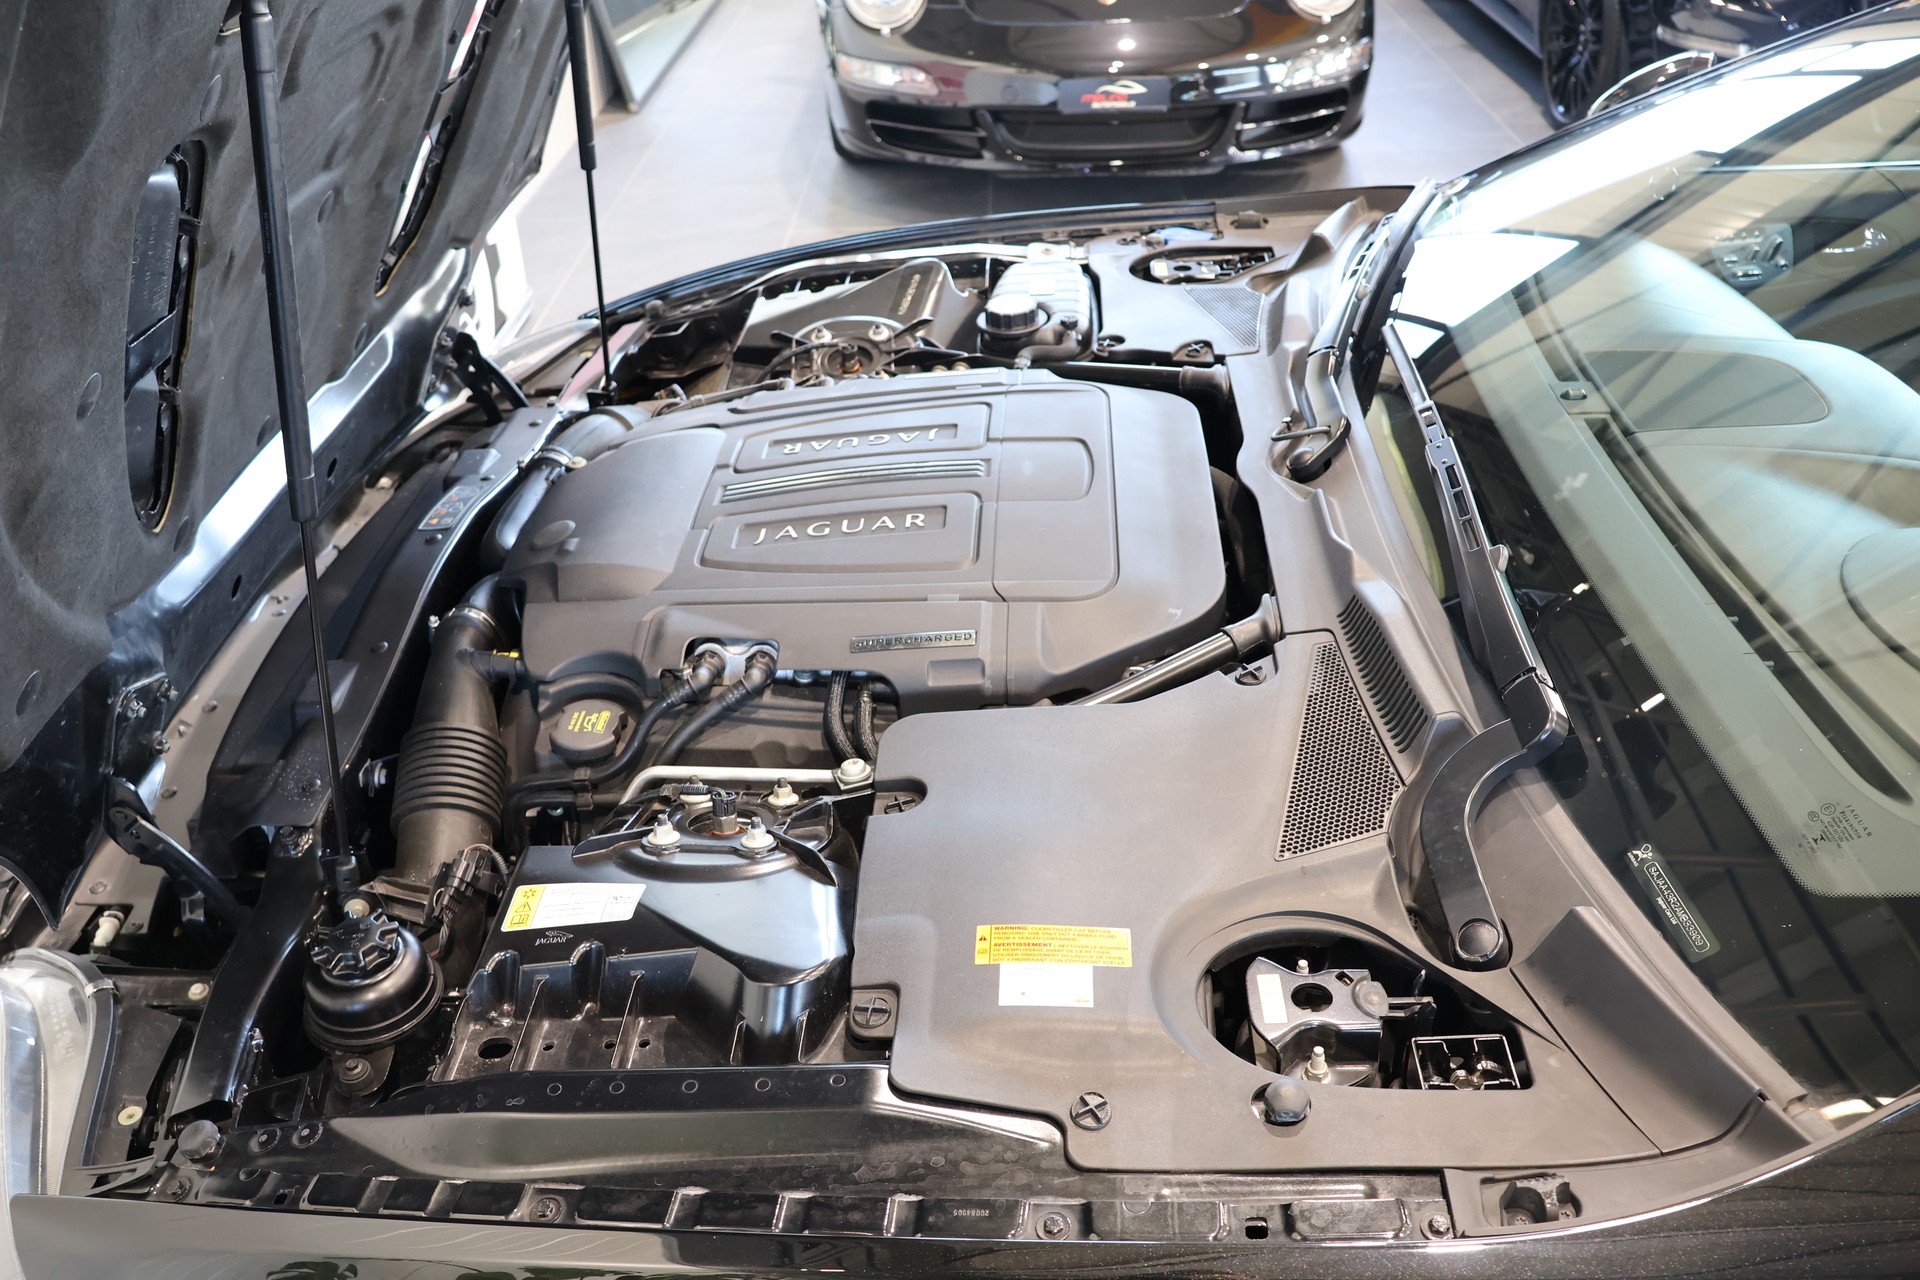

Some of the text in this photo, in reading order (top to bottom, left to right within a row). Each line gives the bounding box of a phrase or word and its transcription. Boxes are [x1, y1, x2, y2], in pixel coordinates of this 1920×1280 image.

[782, 428, 940, 455] JAGUAR
[753, 512, 925, 546] JAGUAR
[855, 632, 973, 648] SUPERCHARGED
[1846, 804, 1873, 838] JAGUAR
[535, 936, 567, 947] JAGUAR
